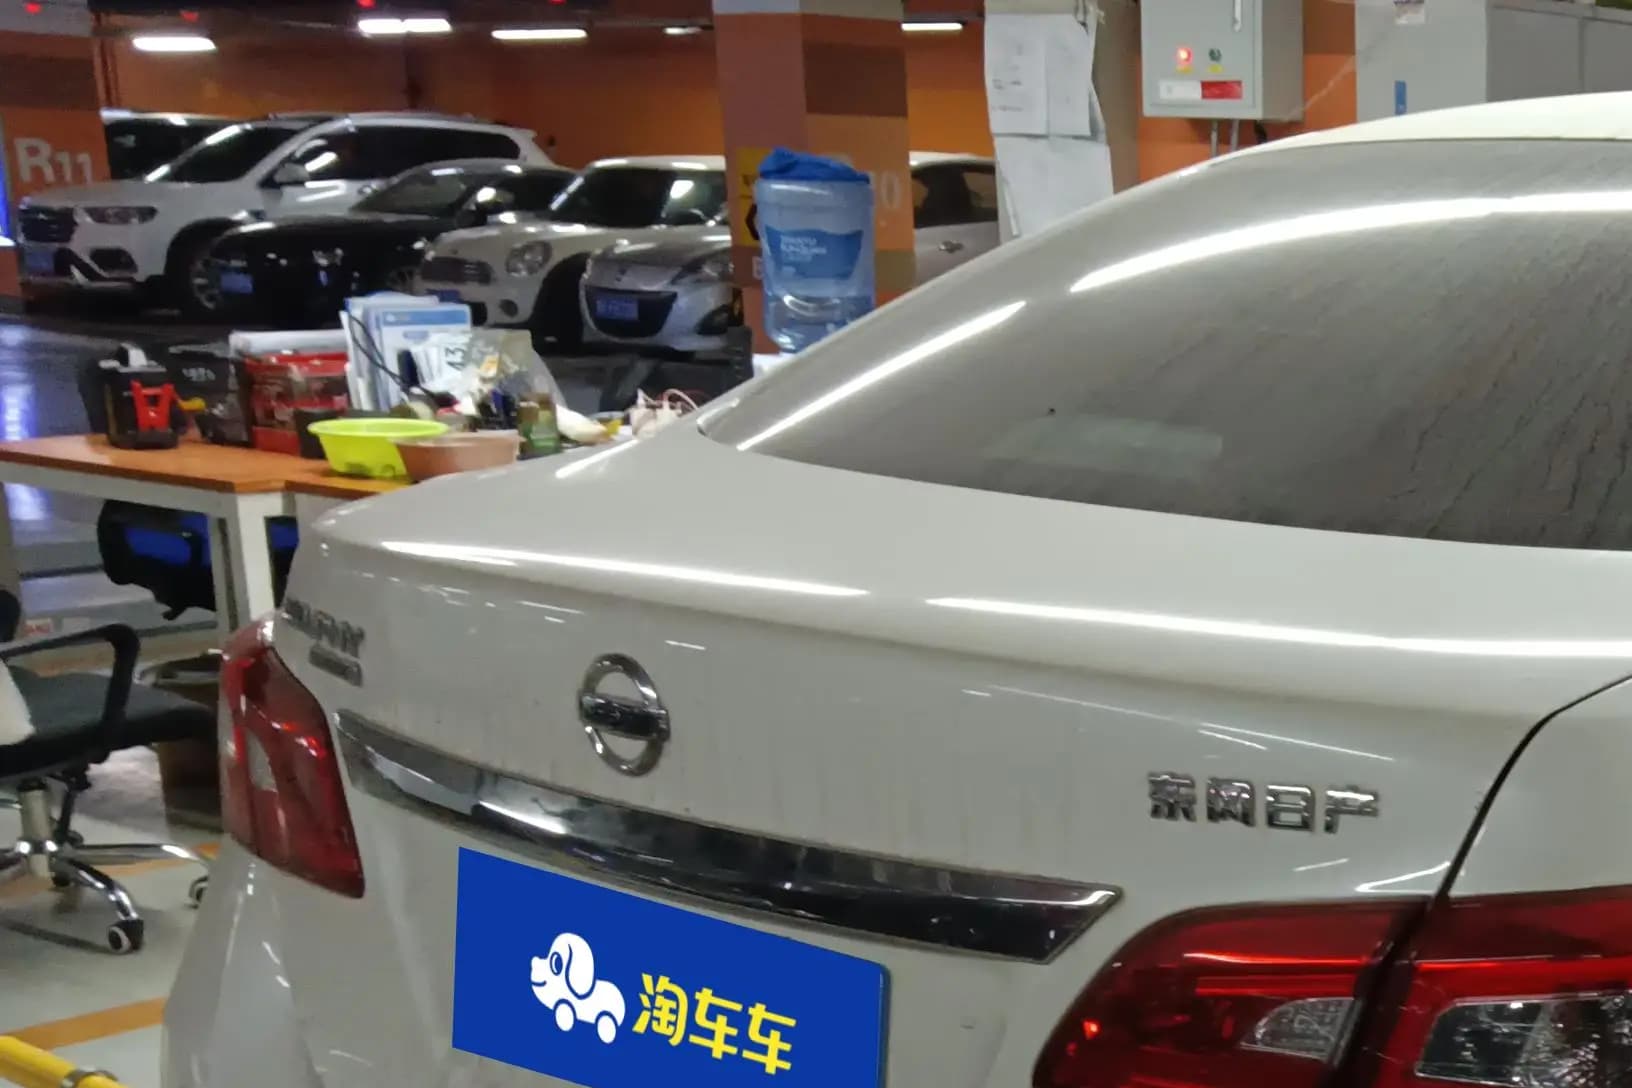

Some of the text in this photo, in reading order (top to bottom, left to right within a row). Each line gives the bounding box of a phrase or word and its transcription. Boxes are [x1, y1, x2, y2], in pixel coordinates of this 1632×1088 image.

[14, 137, 94, 187] R11
[1148, 771, 1379, 835] 东风日产
